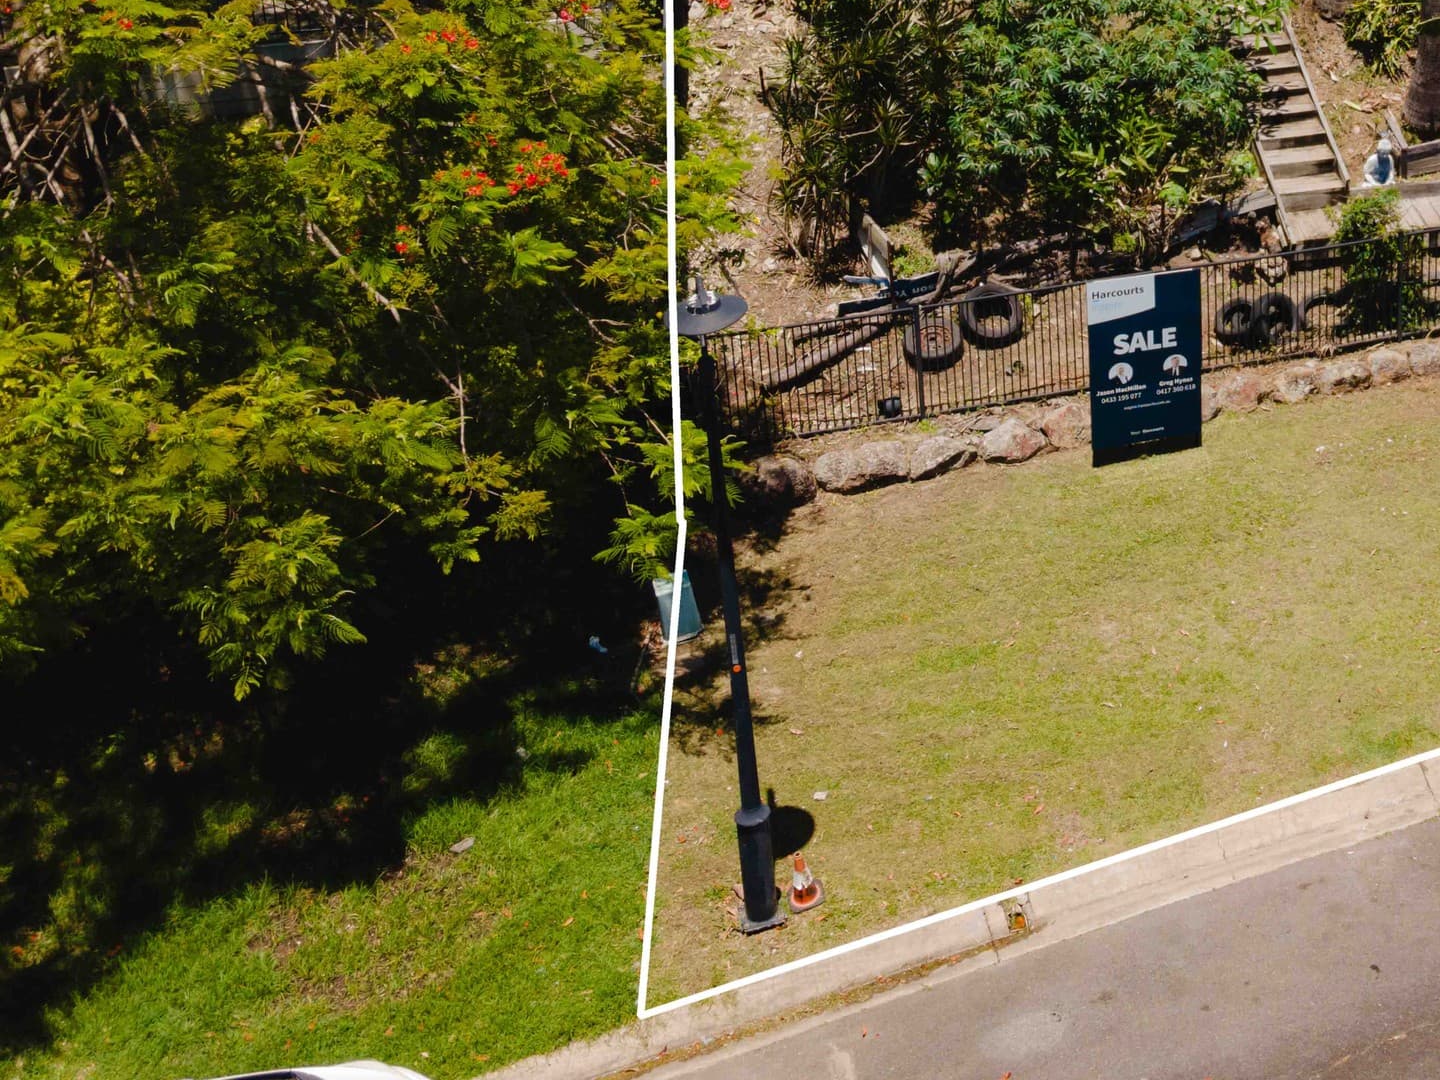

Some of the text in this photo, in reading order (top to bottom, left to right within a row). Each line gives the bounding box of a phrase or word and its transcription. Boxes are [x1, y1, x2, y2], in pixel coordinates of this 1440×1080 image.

[1092, 286, 1144, 300] Harcourts
[1113, 326, 1177, 355] SALE
[1096, 389, 1115, 397] Jason
